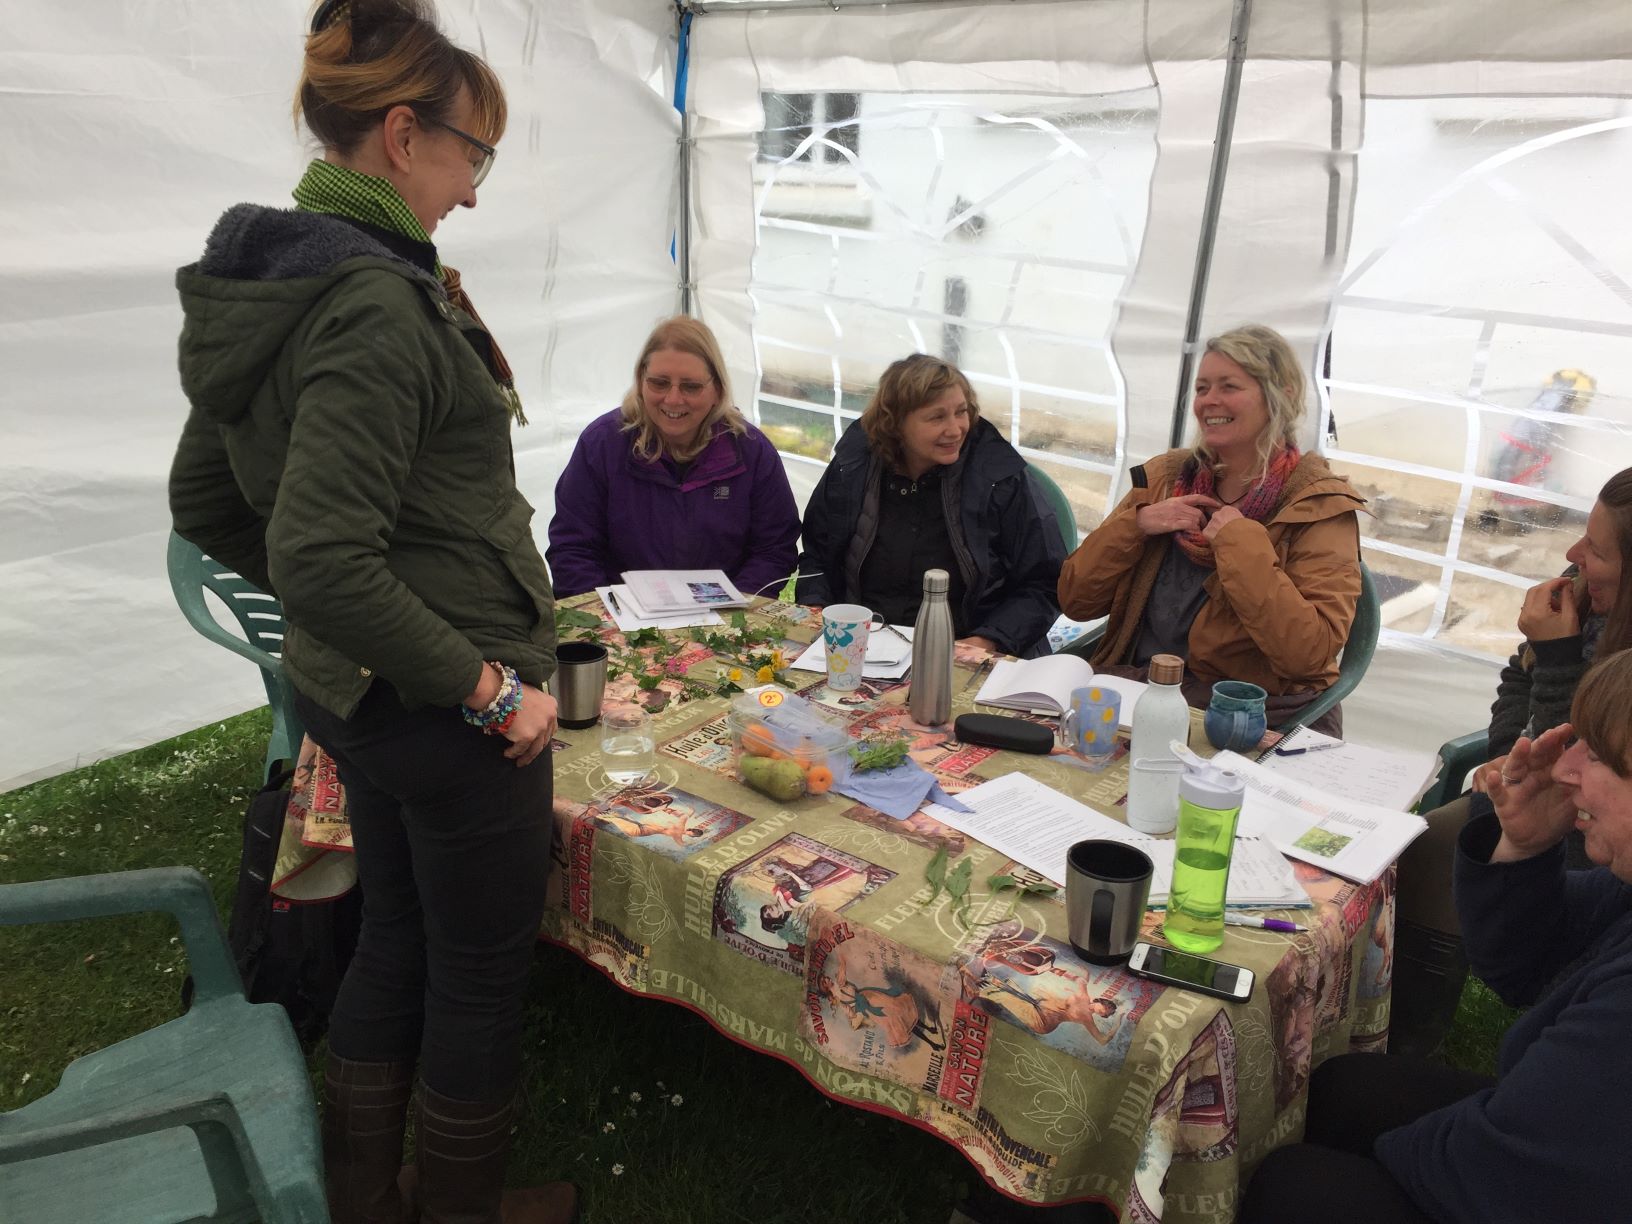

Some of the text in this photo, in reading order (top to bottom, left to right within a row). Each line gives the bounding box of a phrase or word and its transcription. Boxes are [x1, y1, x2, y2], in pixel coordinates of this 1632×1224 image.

[666, 732, 706, 758] Huile
[576, 823, 594, 919] NATURE
[685, 855, 718, 936] HUILE
[714, 809, 799, 859] D'OLIVE
[652, 969, 787, 1050] MARSEILLE
[806, 992, 830, 1046] SAVON
[922, 1051, 944, 1095] MARSEILLE
[949, 1018, 967, 1070] SAVON
[955, 1008, 988, 1106] NATURE
[1108, 1063, 1160, 1138] HUILE
[1143, 991, 1202, 1060] D'OLI
[817, 1063, 913, 1114] SAVON
